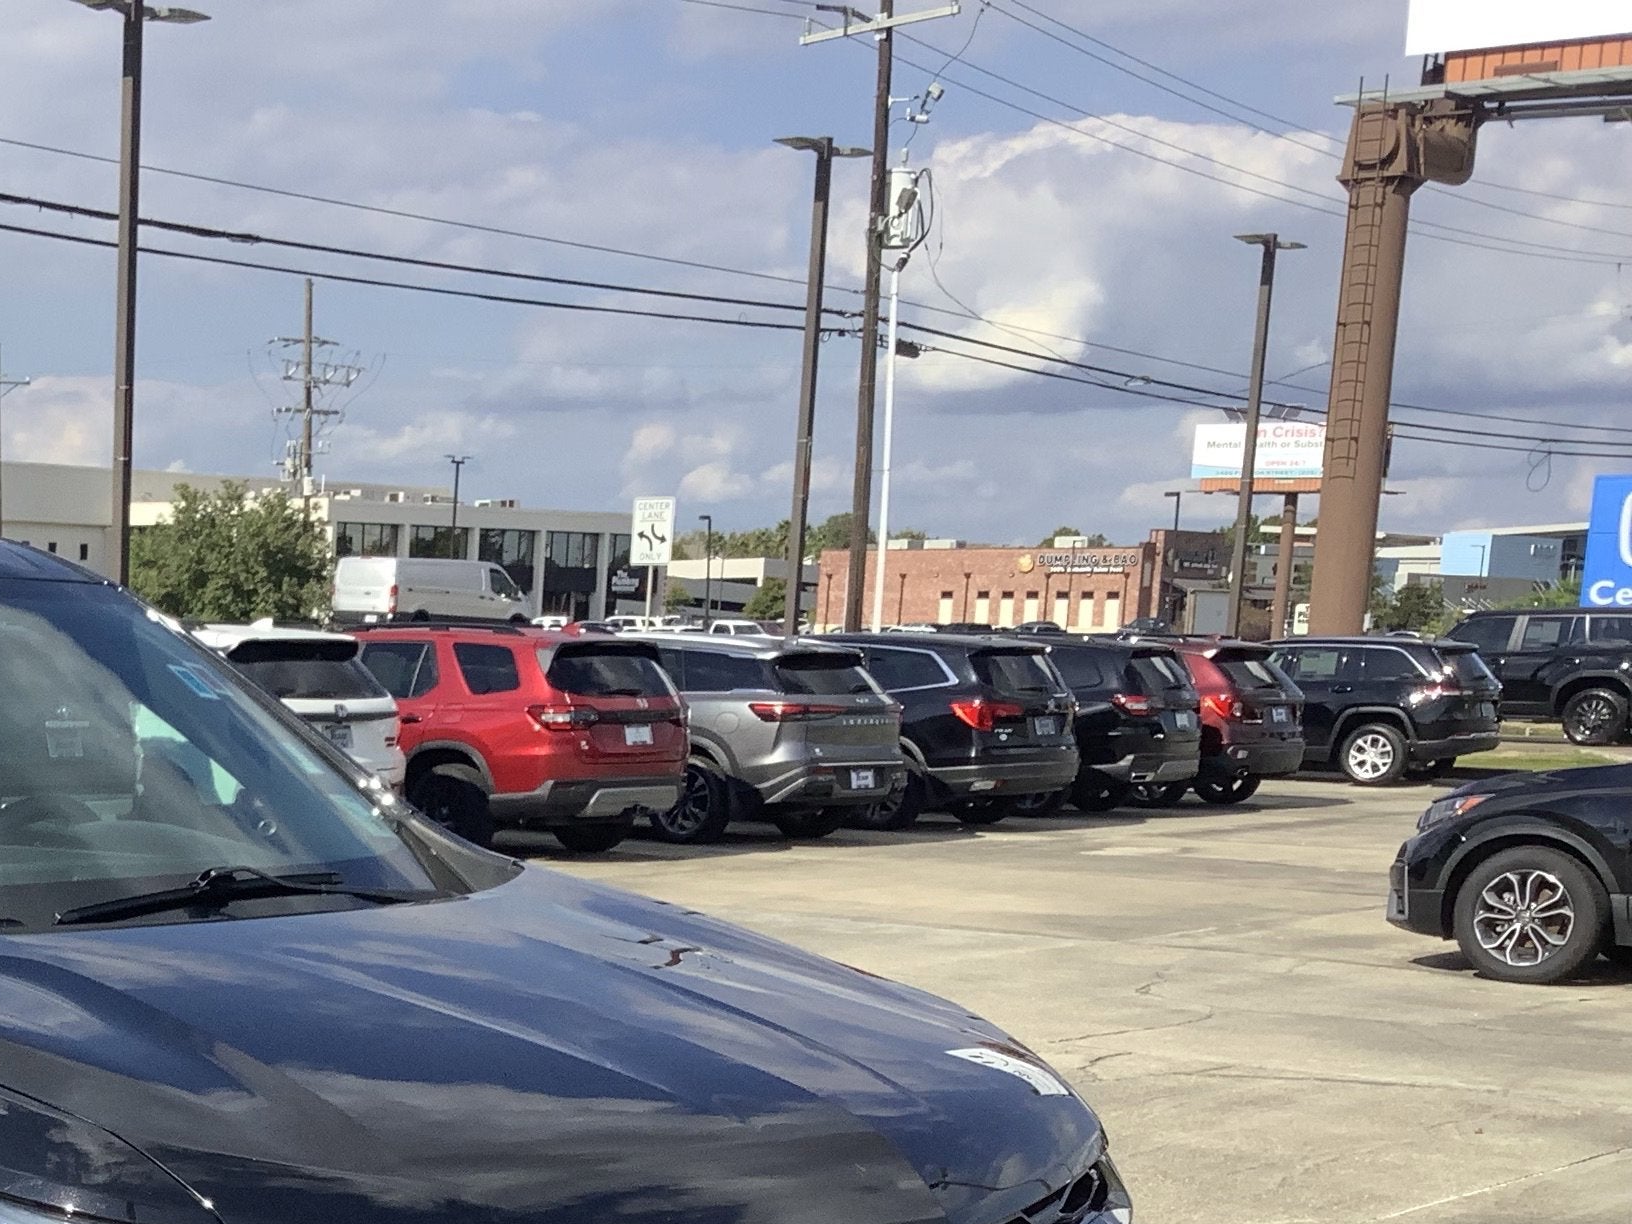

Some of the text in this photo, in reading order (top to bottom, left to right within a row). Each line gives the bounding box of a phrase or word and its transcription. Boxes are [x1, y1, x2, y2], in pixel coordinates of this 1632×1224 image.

[1207, 441, 1241, 449] Mental
[1258, 441, 1278, 449] alth
[638, 502, 671, 511] CENTER
[642, 511, 665, 520] LANE
[640, 552, 662, 561] ONLY
[1113, 554, 1137, 566] BAO
